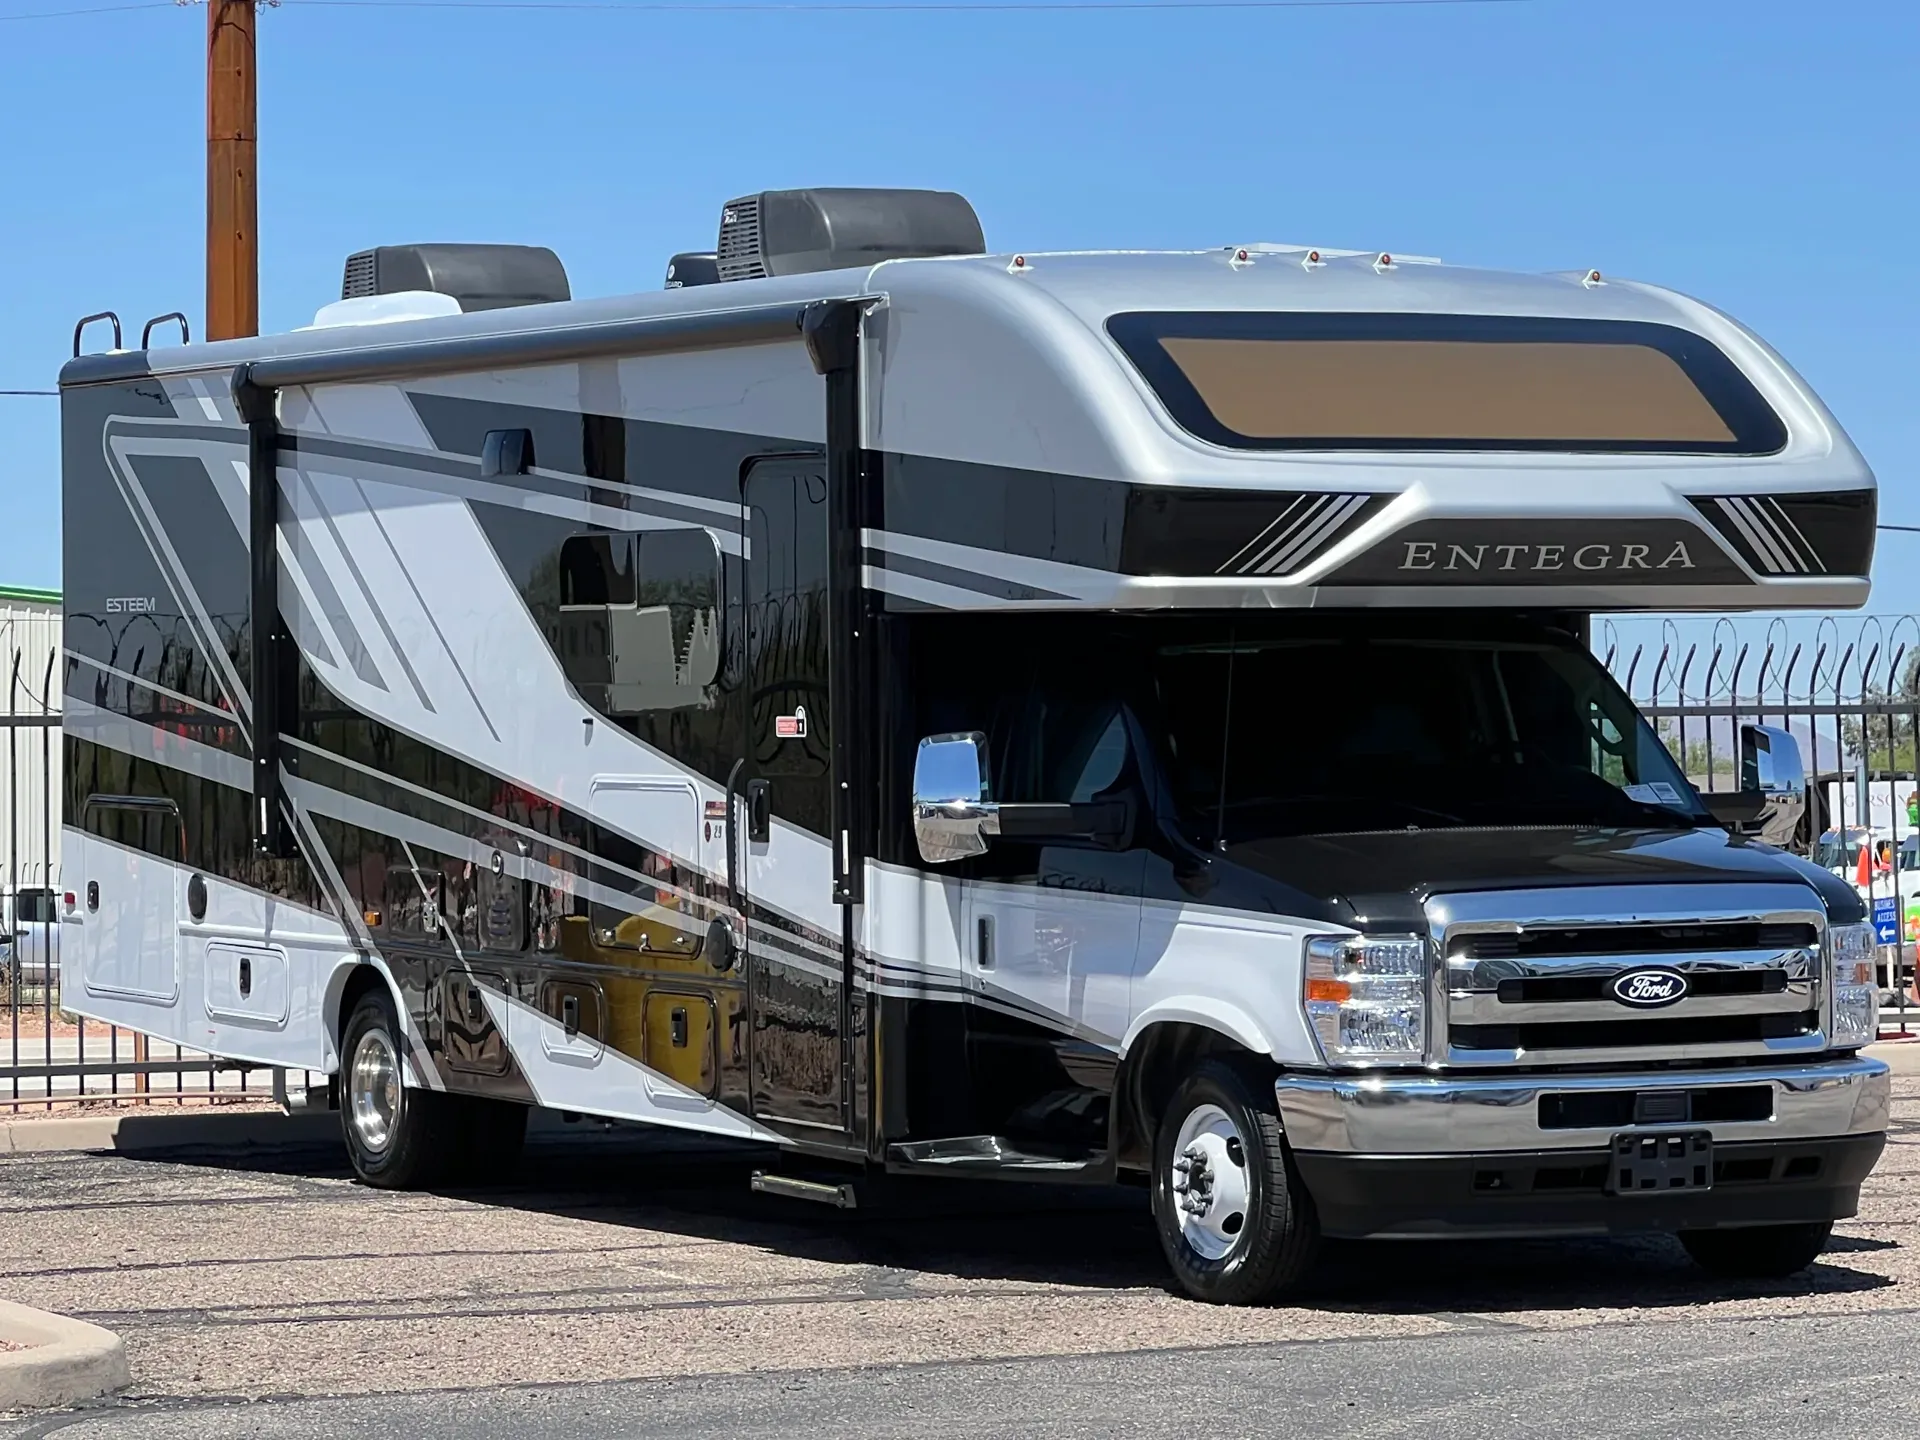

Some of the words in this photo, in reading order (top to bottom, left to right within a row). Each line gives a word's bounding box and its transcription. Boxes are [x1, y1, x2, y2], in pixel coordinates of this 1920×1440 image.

[1397, 541, 1696, 571] ENTEGRA
[106, 596, 156, 612] ESTEEM
[1628, 975, 1674, 998] Ford
